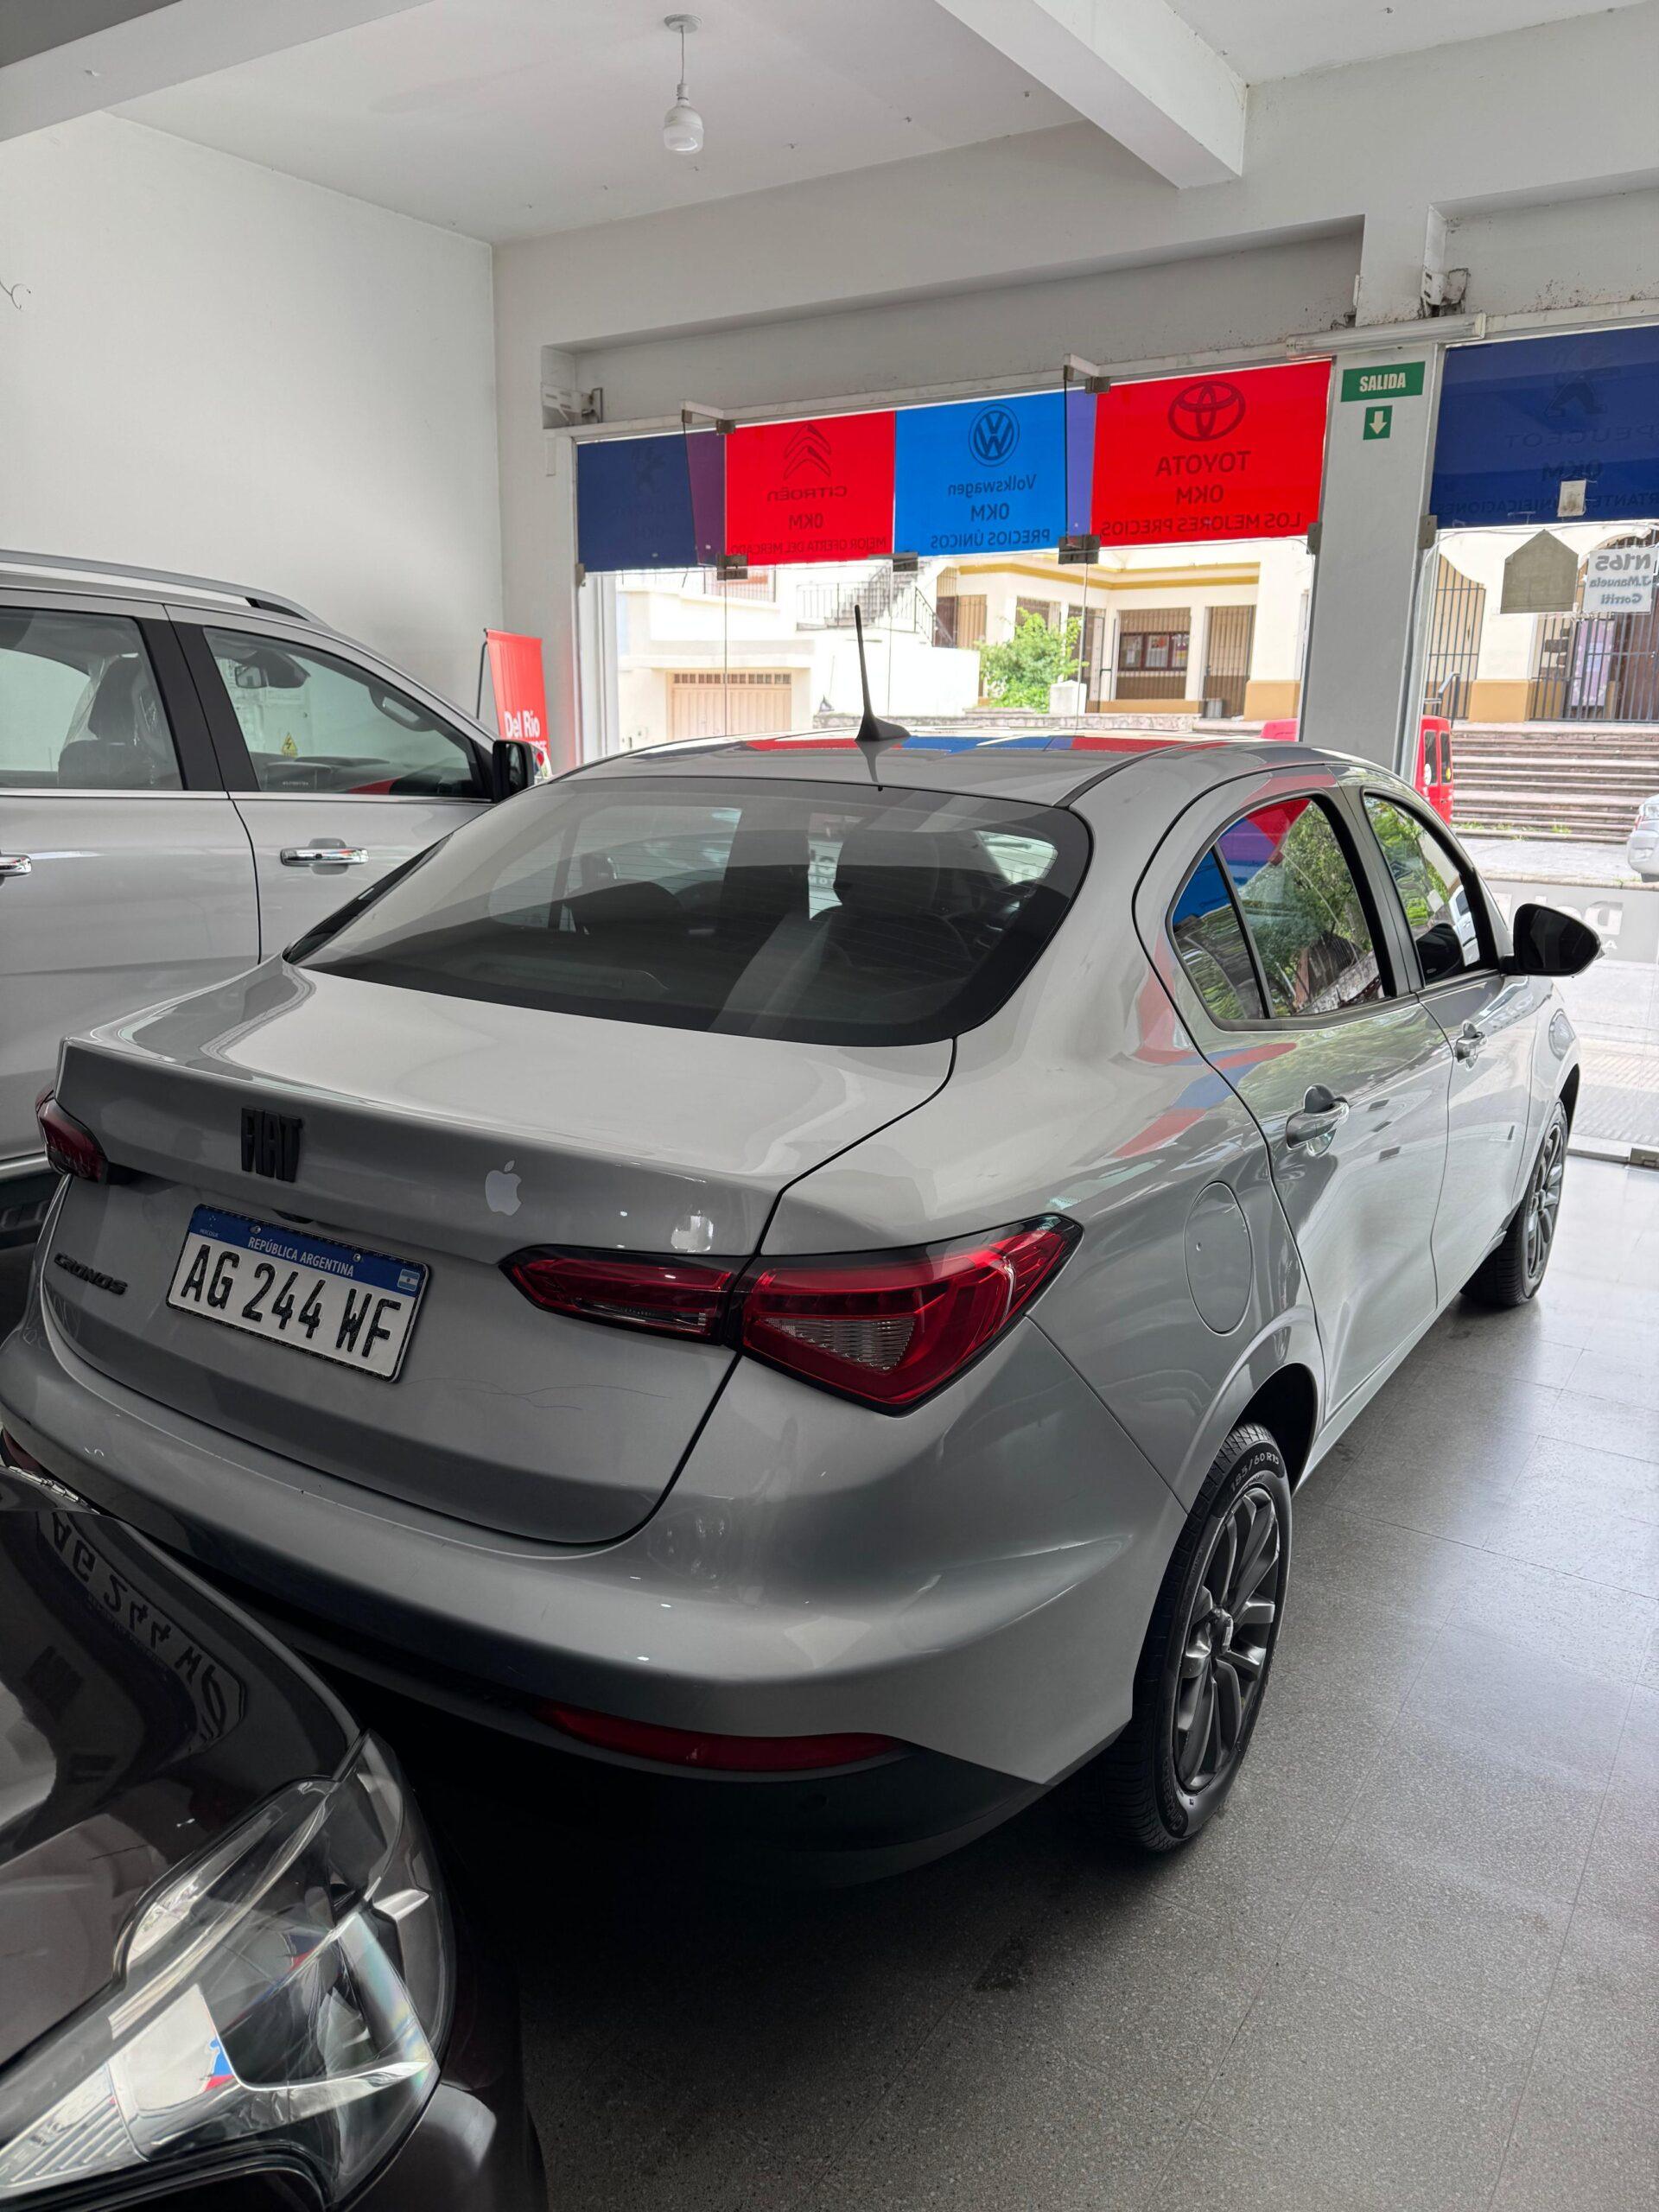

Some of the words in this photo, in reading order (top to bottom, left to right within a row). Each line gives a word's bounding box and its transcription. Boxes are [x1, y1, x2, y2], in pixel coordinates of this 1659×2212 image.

[1359, 372, 1406, 392] SALIDA
[504, 710, 522, 739] Del
[241, 1107, 303, 1183] FIAT
[54, 1252, 128, 1295] CRONOS
[247, 1236, 299, 1262] REPÚBLICA
[300, 1250, 354, 1278] ARGENTINA
[181, 1244, 241, 1310] AG
[242, 1262, 327, 1339] 244
[335, 1287, 402, 1357] WF
